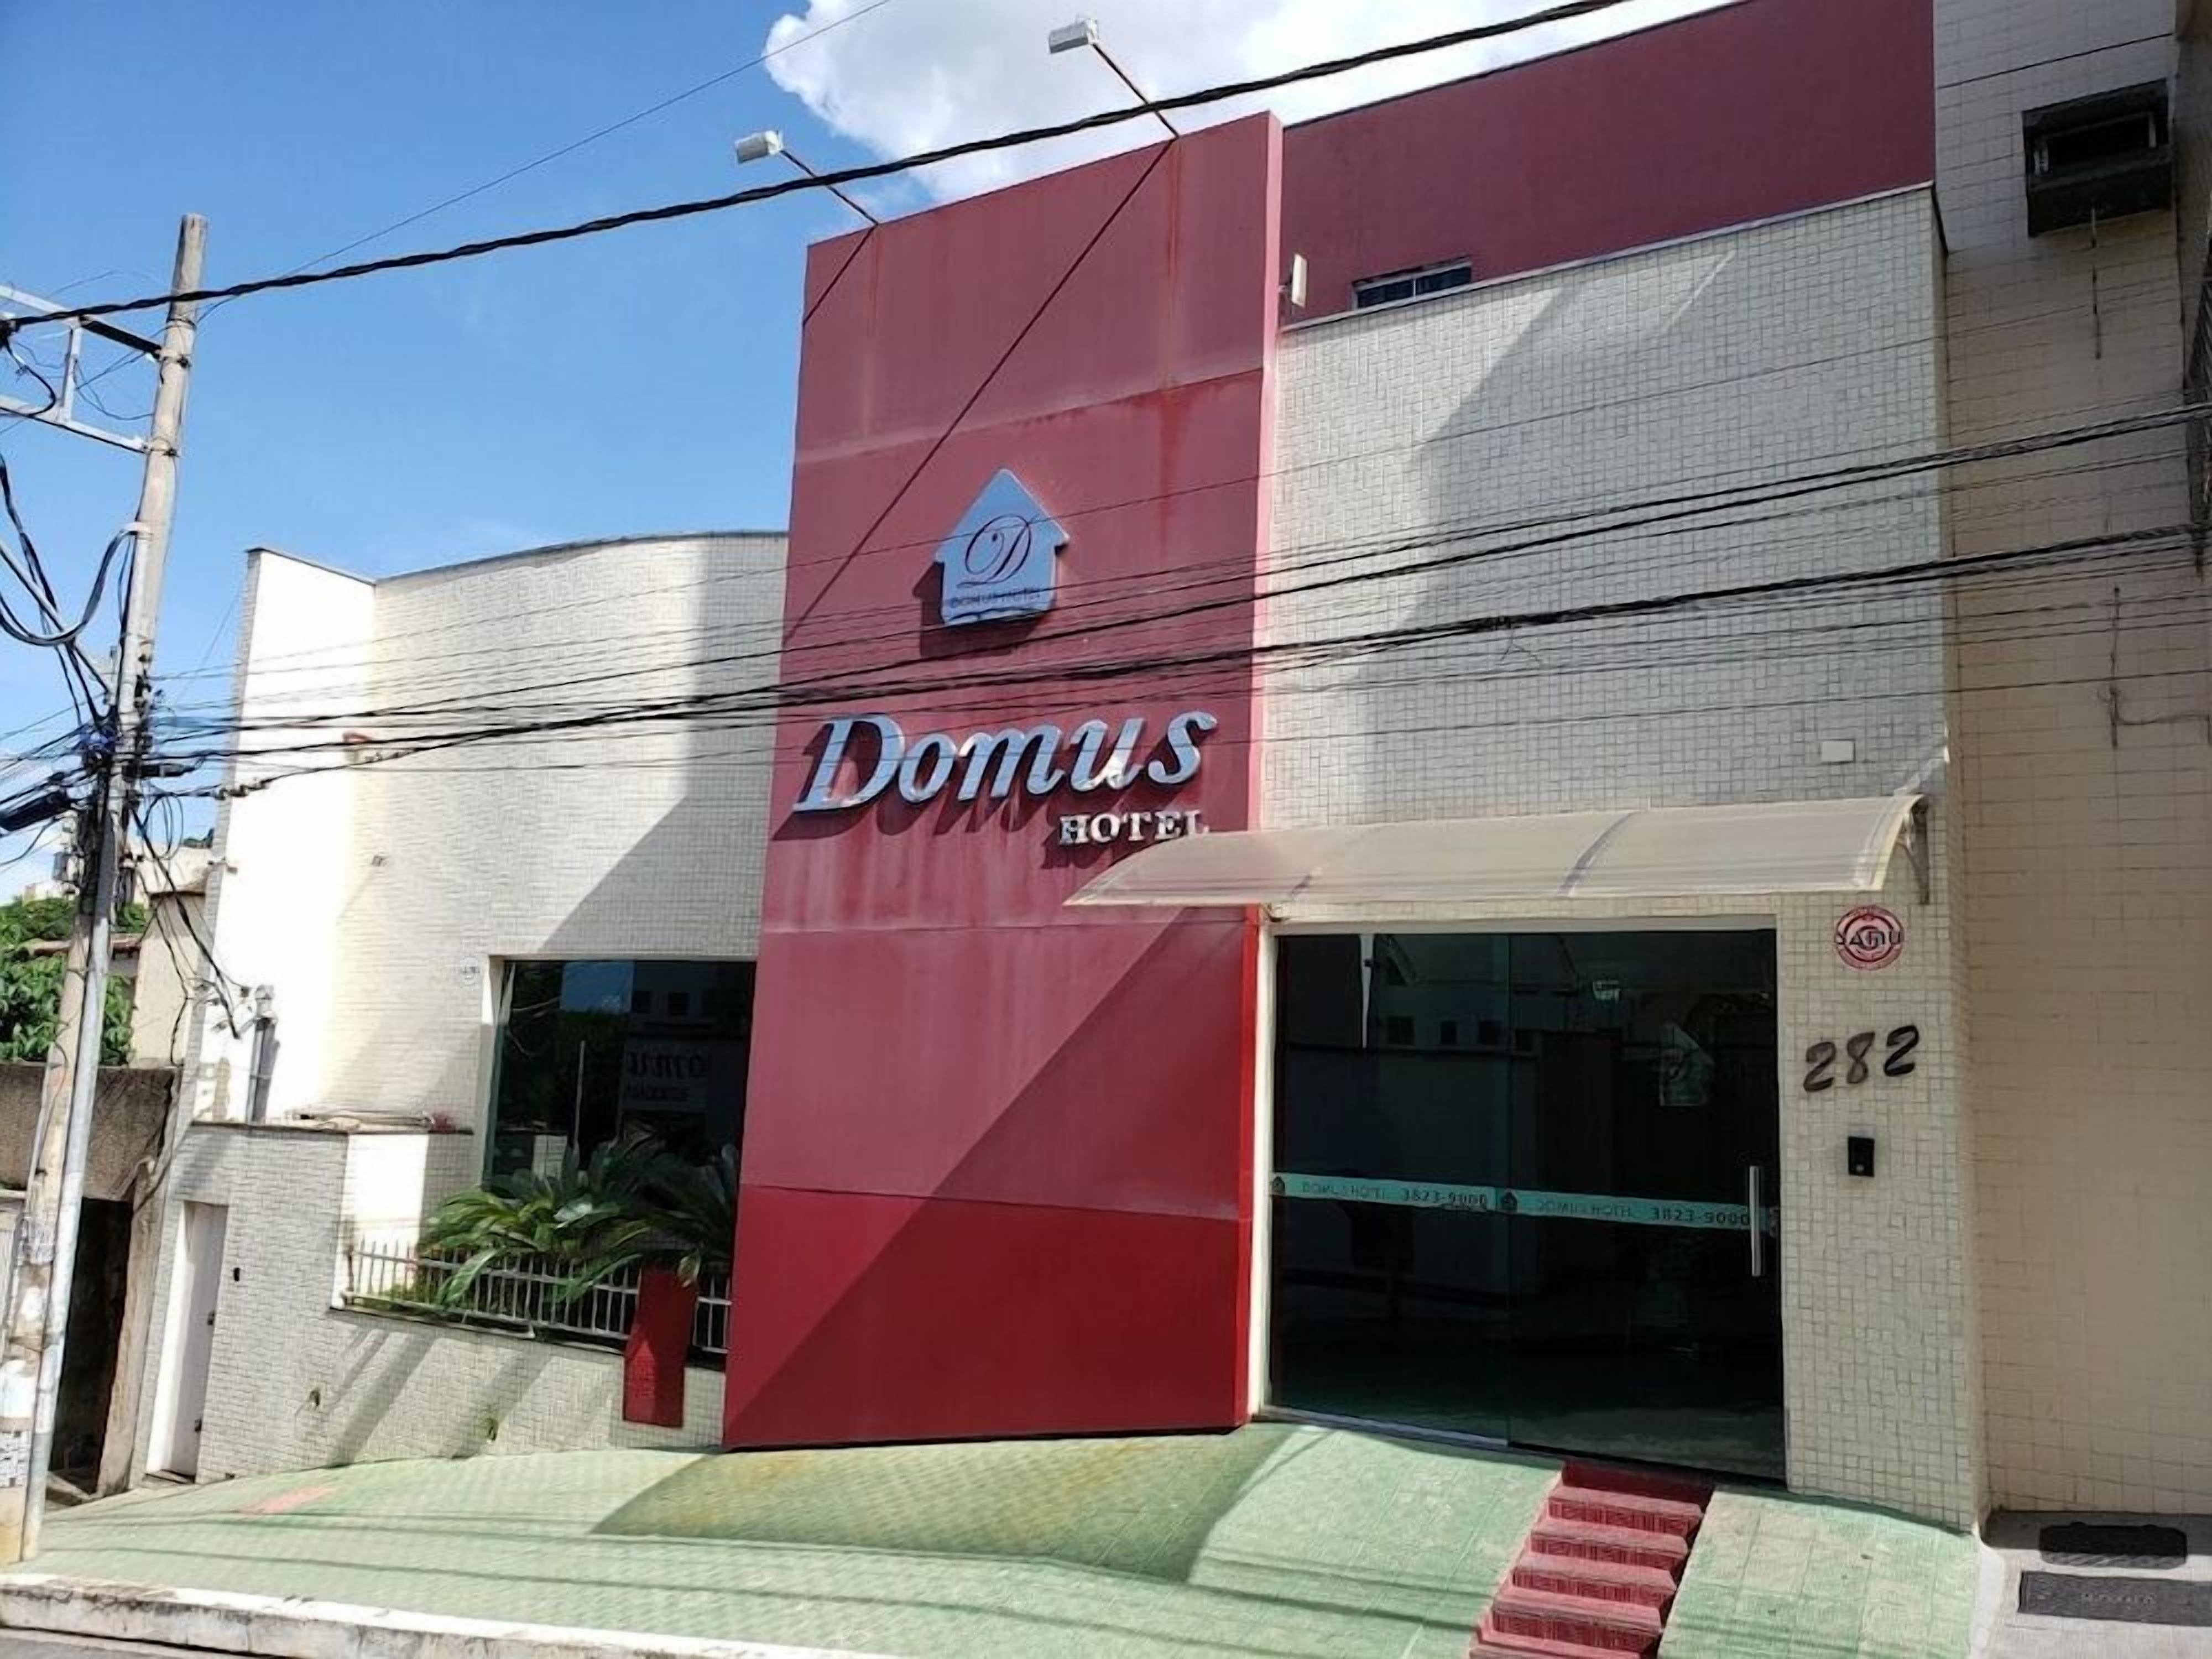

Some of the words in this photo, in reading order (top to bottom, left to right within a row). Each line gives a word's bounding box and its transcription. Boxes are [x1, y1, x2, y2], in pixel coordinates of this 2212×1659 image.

[794, 711, 1217, 814] Domus
[1059, 809, 1210, 846] HOTEL
[1803, 1025, 1920, 1093] 282
